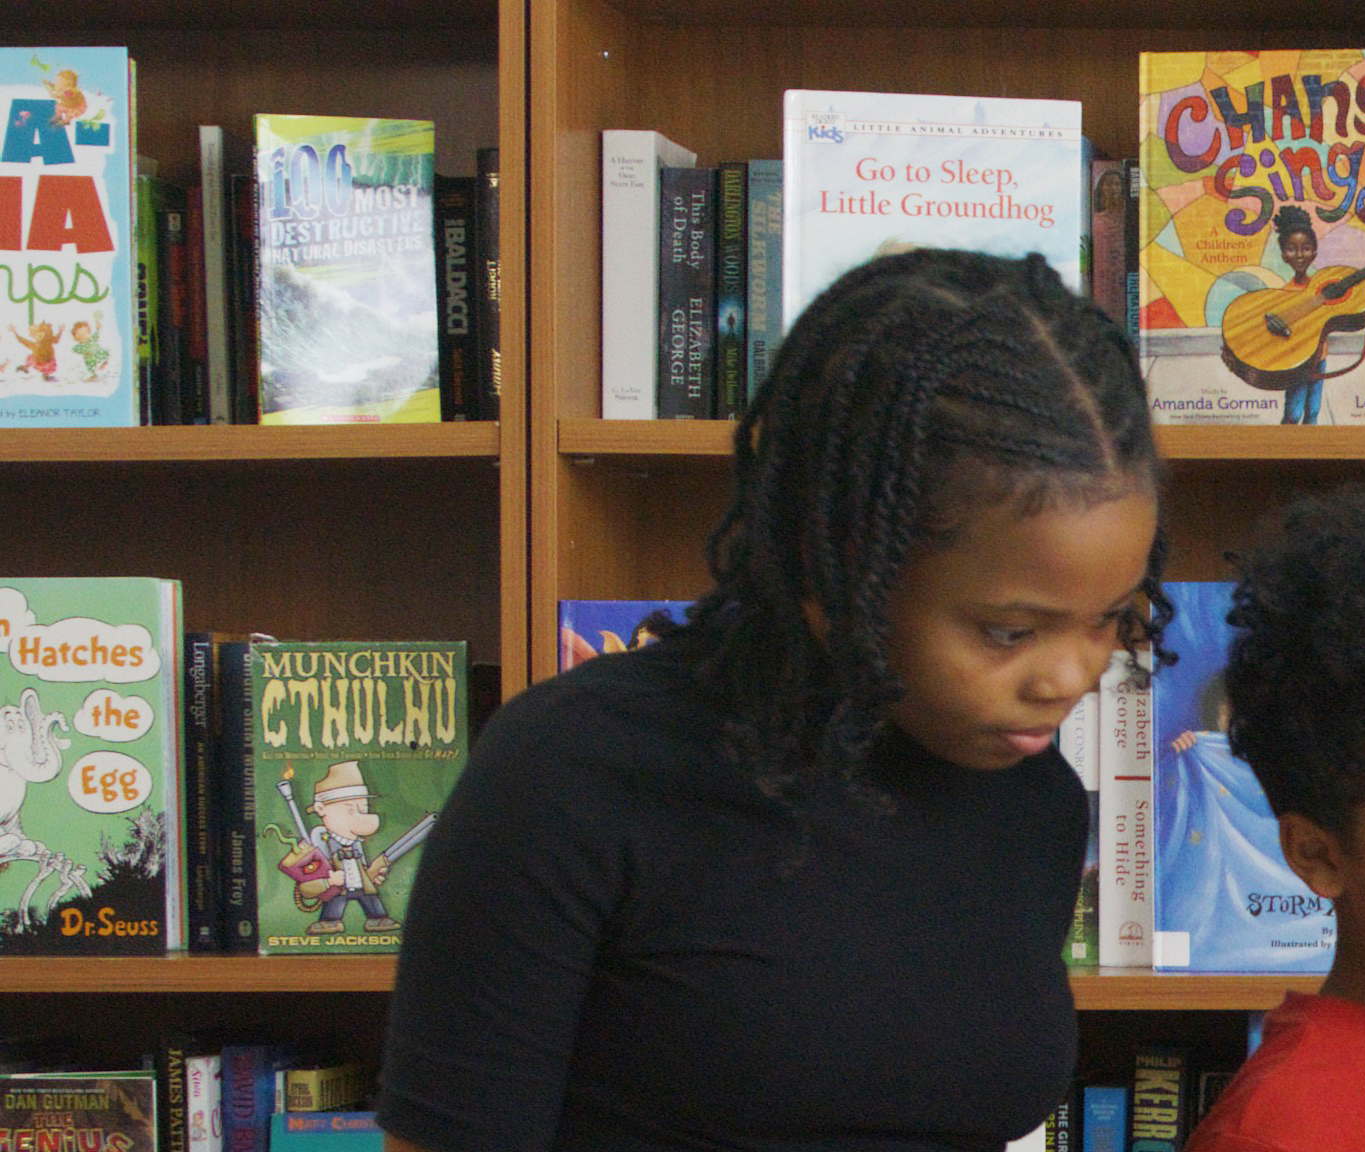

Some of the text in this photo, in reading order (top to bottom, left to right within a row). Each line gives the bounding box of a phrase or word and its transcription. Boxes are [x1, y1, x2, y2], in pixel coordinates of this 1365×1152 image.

[808, 125, 844, 144] Kids
[853, 123, 1065, 138] LITTLE ANIMAL ADVENTURES
[268, 143, 352, 221] 100
[353, 184, 422, 214] MOST
[855, 157, 1019, 190] Go to Sleep,
[723, 169, 743, 240] DARLINGTON
[818, 189, 1055, 228] Little Groundhog
[270, 211, 425, 248] DESTRUCTIVE
[672, 196, 688, 263] of Death
[686, 190, 706, 270] This Body
[1196, 239, 1253, 251] Children's
[1209, 226, 1219, 237] A
[271, 236, 422, 265] NATURAL DISASTERS
[1201, 252, 1248, 264] Anthem
[445, 228, 469, 336] BALDACCI
[670, 308, 686, 386] GEORGE
[688, 297, 703, 399] ELIZABETH
[1152, 396, 1279, 410] Amanda Gorman
[18, 637, 144, 668] Hatches
[262, 651, 457, 684] MUNCHKIN
[188, 641, 210, 729] Longaberger
[91, 698, 141, 730] the
[261, 677, 457, 749] CTHULHU
[1114, 681, 1131, 750] George
[80, 765, 140, 802] Egg
[229, 829, 246, 906] James Frey
[1115, 814, 1130, 887] to Hide
[1131, 800, 1149, 902] Something
[268, 936, 401, 946] STEVE JACKSON
[1271, 940, 1319, 948] Illustrated
[1322, 927, 1334, 936] By
[167, 1048, 183, 1104] JAMES
[5, 1093, 110, 1110] DAN GUTMAN
[1058, 1103, 1069, 1129] THE
[1133, 1068, 1180, 1139] KERR
[33, 1112, 74, 1128] THE
[1045, 1131, 1055, 1148] IN
